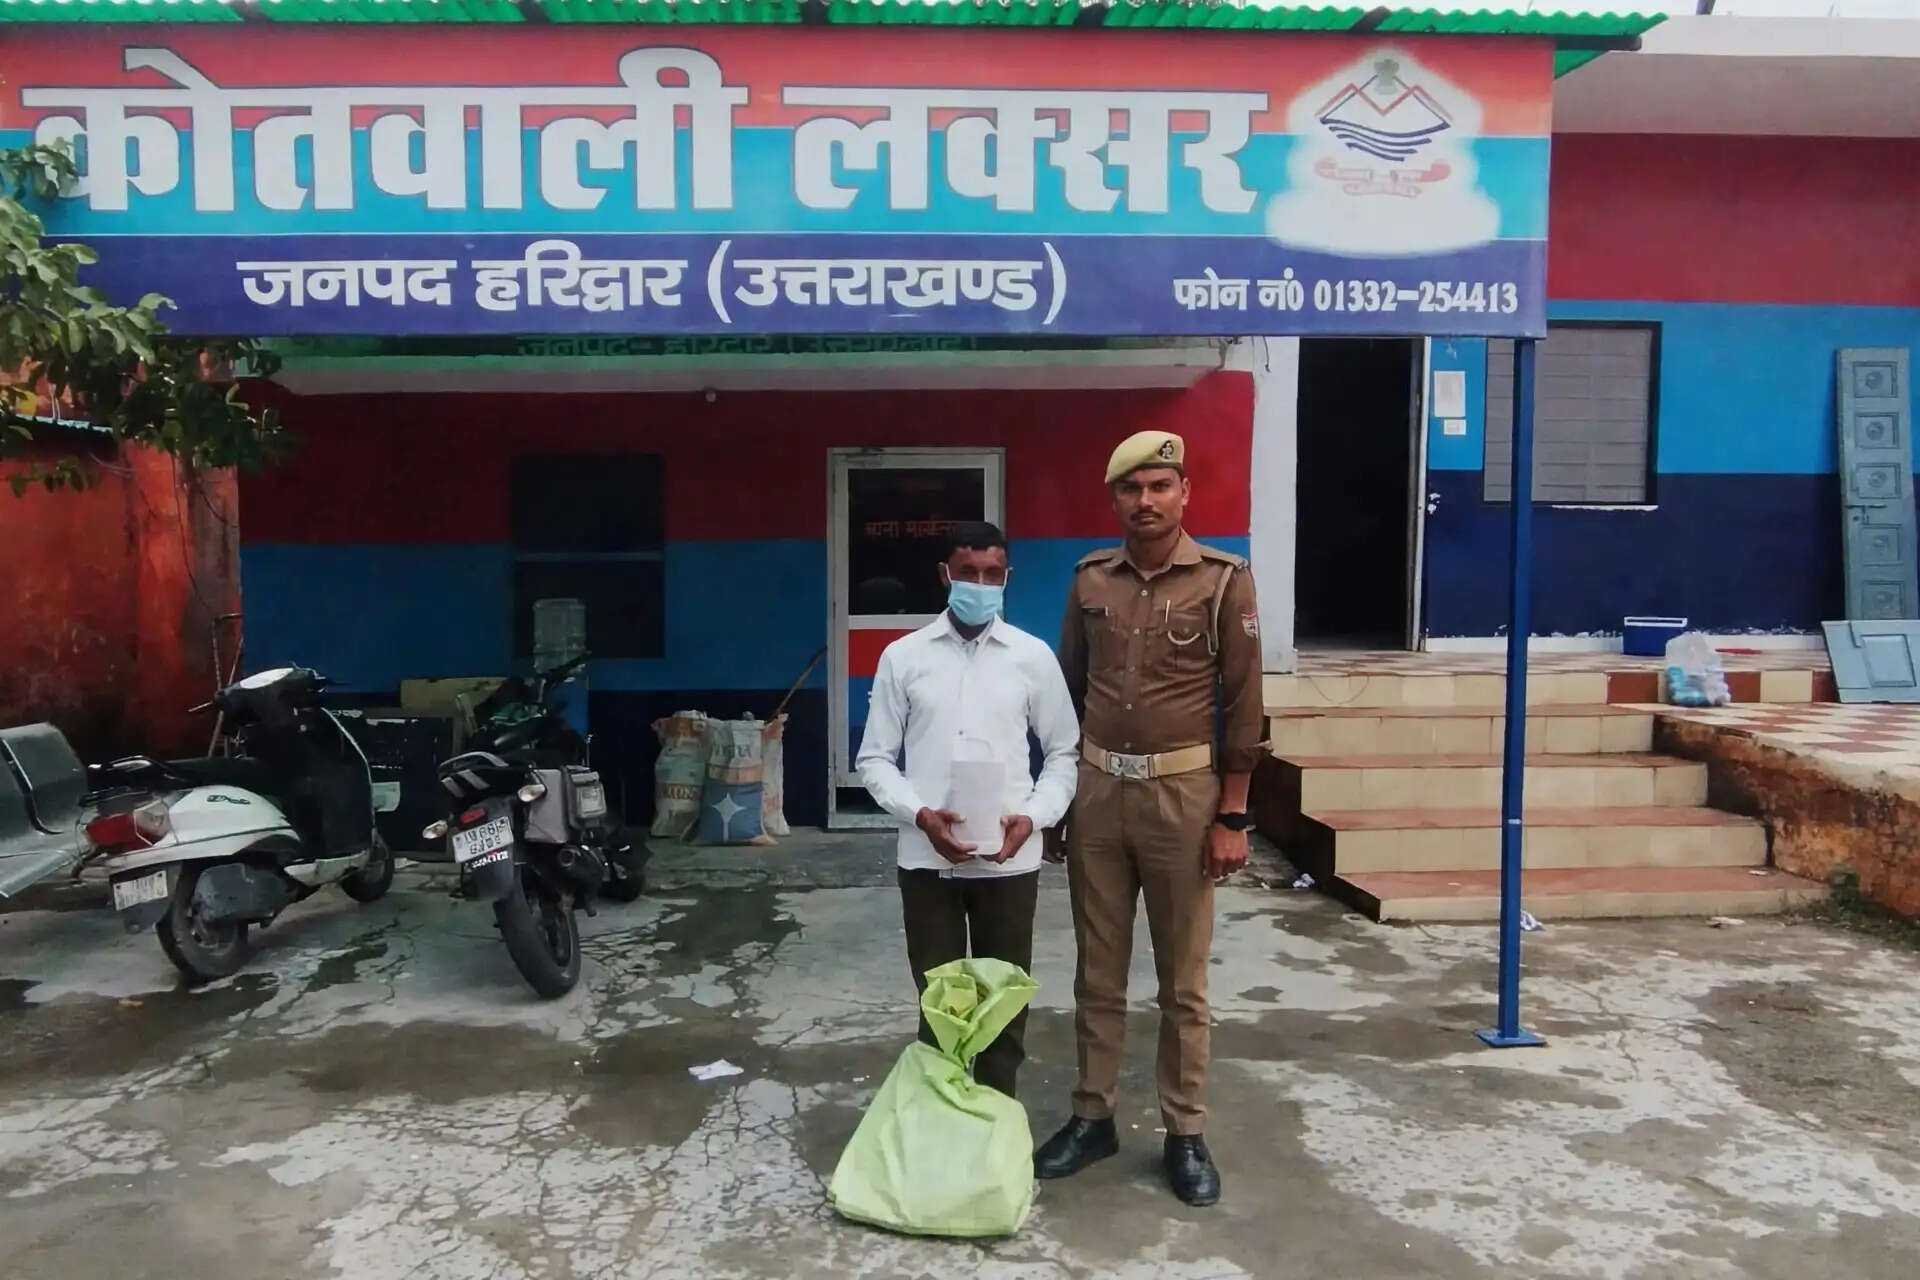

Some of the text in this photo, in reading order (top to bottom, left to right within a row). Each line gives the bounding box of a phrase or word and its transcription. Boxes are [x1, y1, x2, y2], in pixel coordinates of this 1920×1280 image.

[21, 47, 1269, 213] कोतवाली लक्सर
[236, 239, 1068, 325] जनपद हरिद्वार (उत्तराखण्ड)
[1173, 267, 1250, 311] फोन
[1313, 279, 1519, 315] 01332-254413
